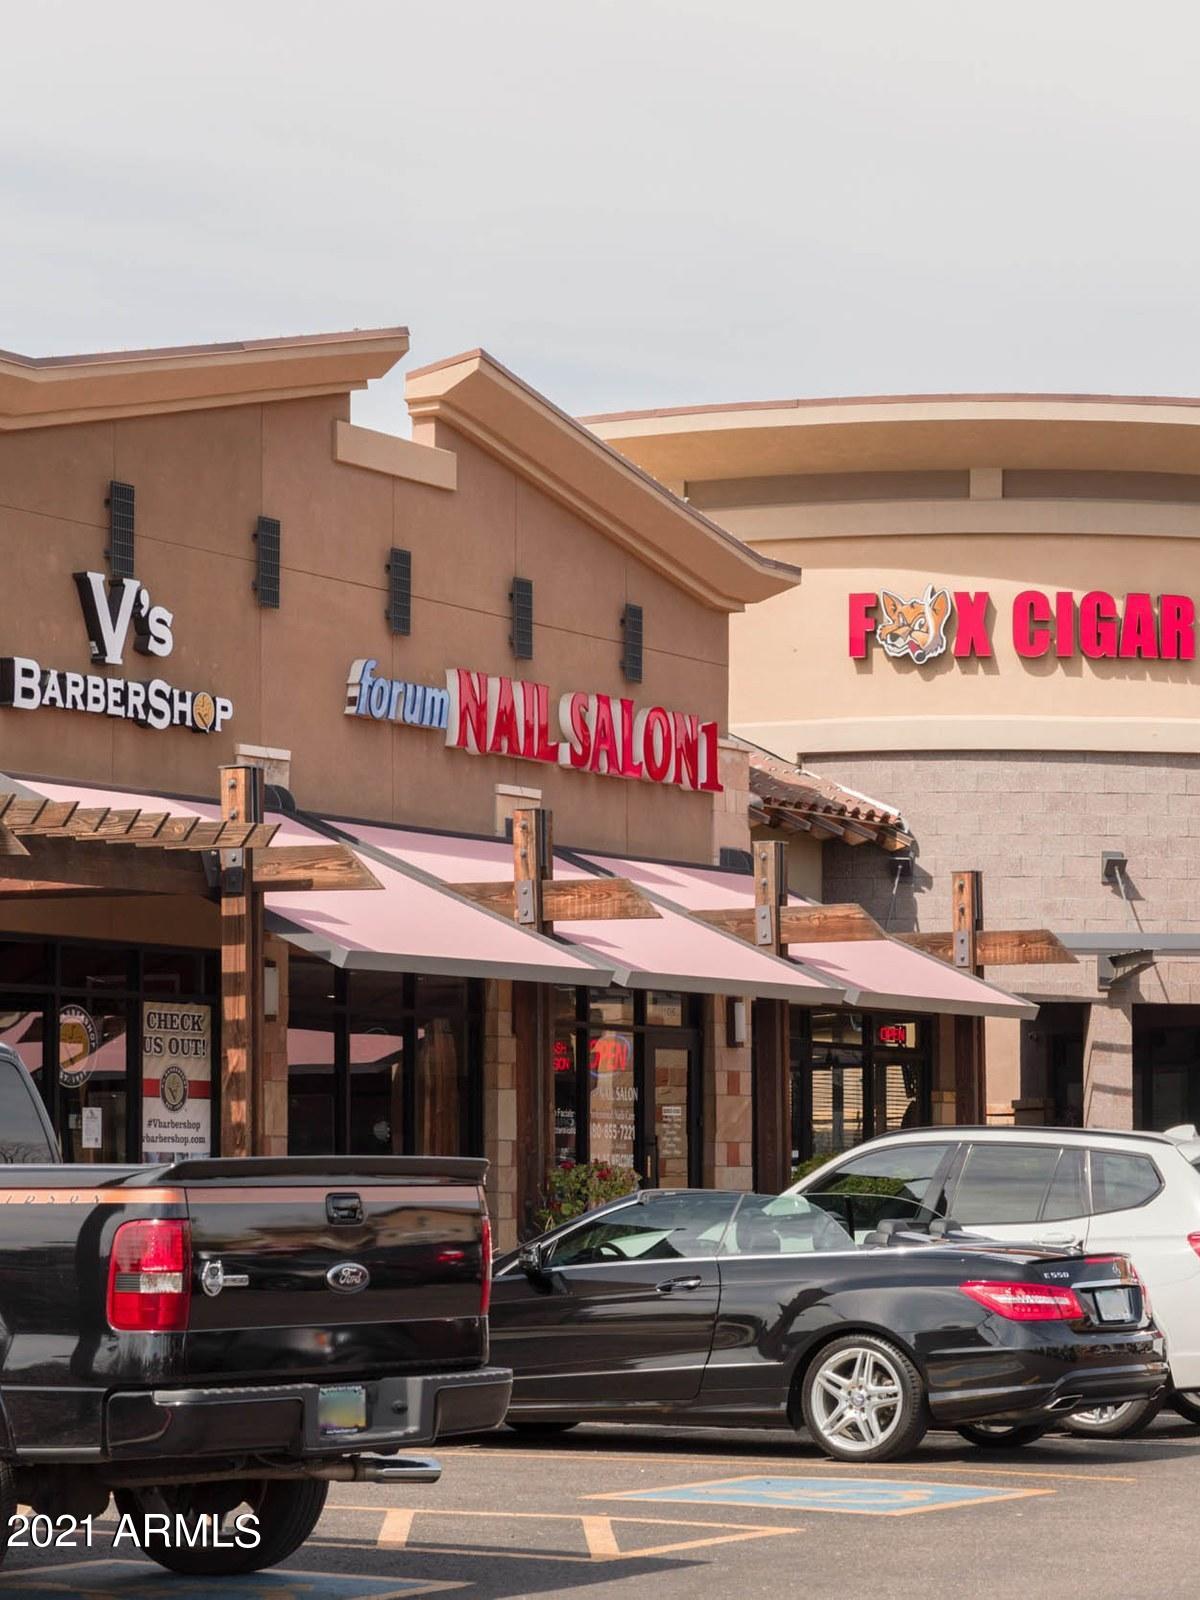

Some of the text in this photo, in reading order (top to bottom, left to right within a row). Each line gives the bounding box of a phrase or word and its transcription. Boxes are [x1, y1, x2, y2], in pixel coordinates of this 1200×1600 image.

[1012, 590, 1196, 660] CIGAR
[357, 659, 449, 729] forum
[456, 668, 558, 763] NAIL
[146, 1011, 203, 1032] CHECK
[880, 1026, 905, 1041] OPEN
[142, 1037, 207, 1057] US OUT!
[588, 1036, 628, 1071] OPEN
[339, 1267, 362, 1284] Ford
